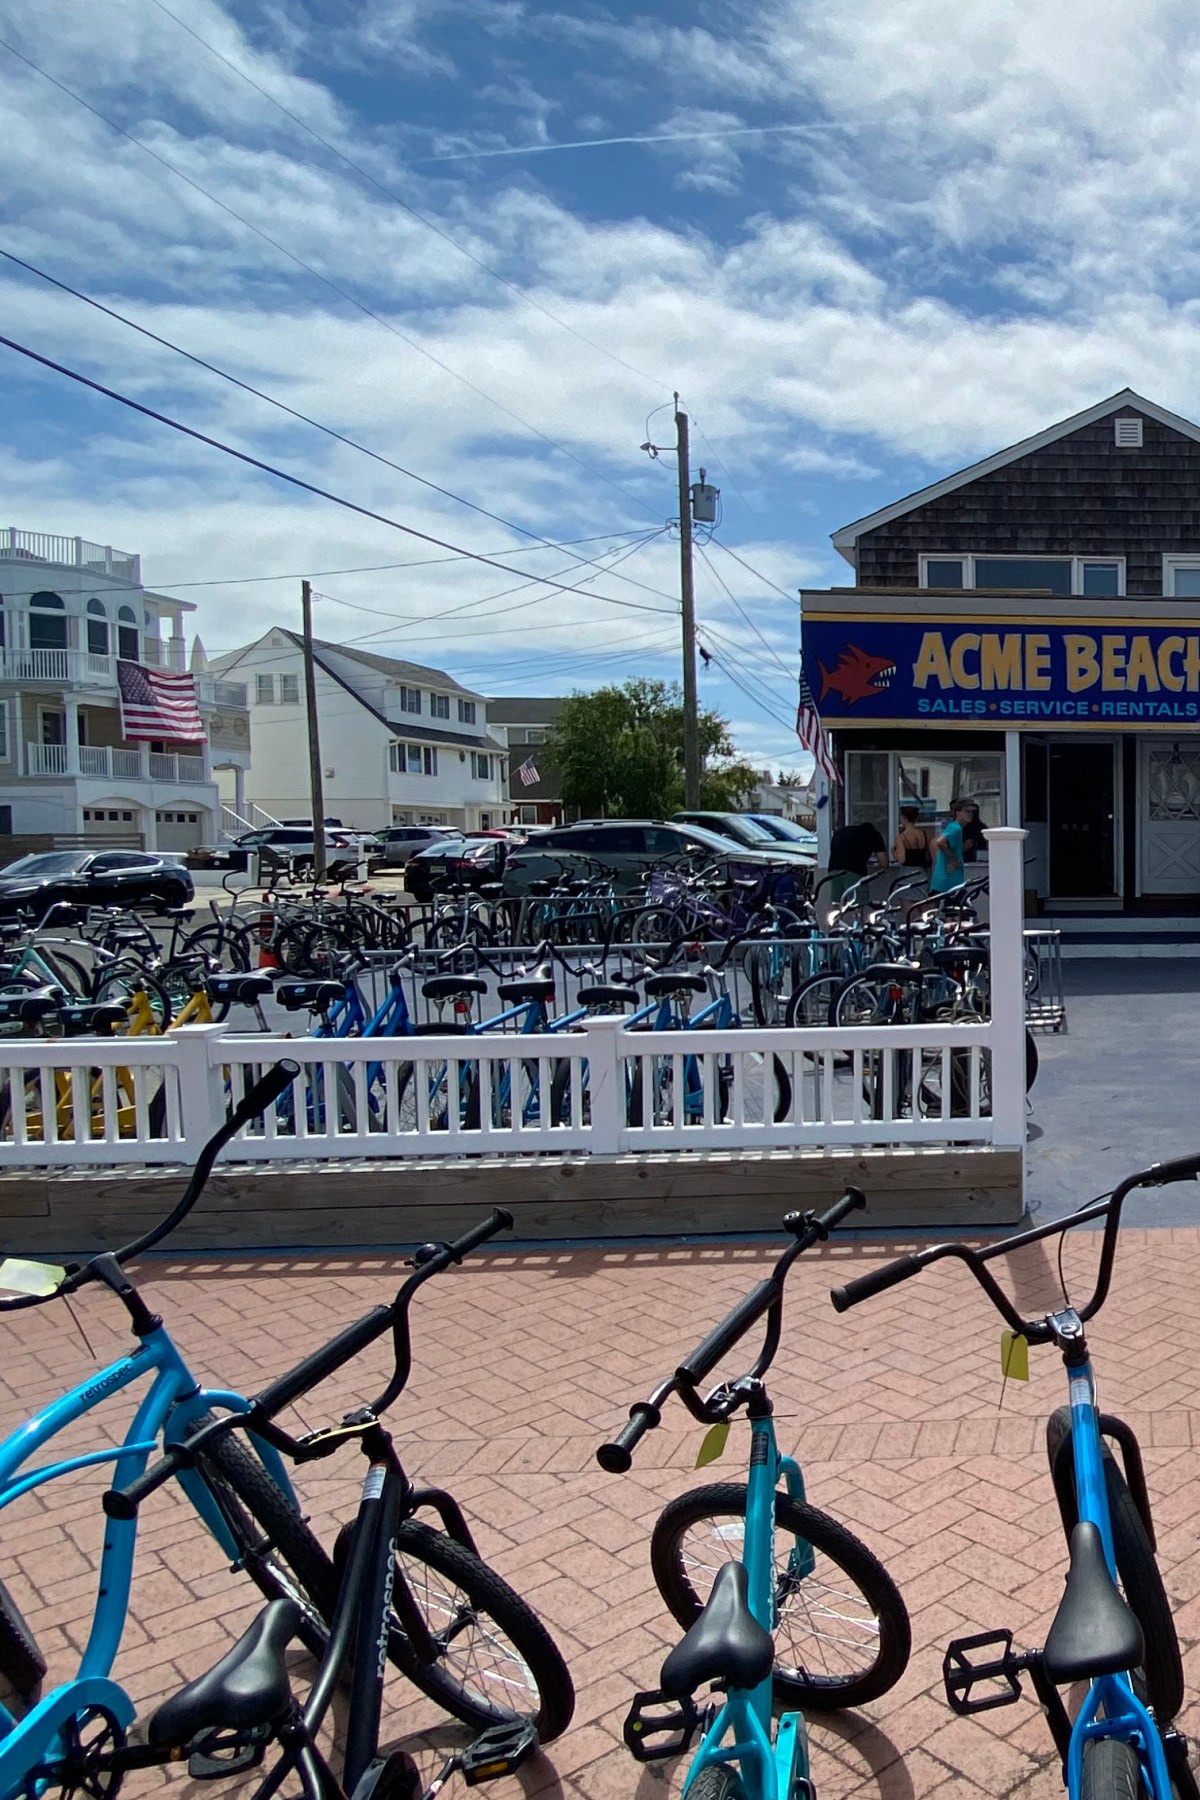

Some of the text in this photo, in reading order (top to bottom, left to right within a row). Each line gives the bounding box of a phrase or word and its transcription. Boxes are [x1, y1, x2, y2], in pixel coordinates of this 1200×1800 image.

[913, 632, 1052, 691] ACME
[917, 699, 987, 713] SALES
[999, 701, 1089, 715] SERVICE
[1101, 702, 1198, 716] RENTALS
[79, 1363, 134, 1403] retrospec
[376, 1537, 398, 1678] retrospec
